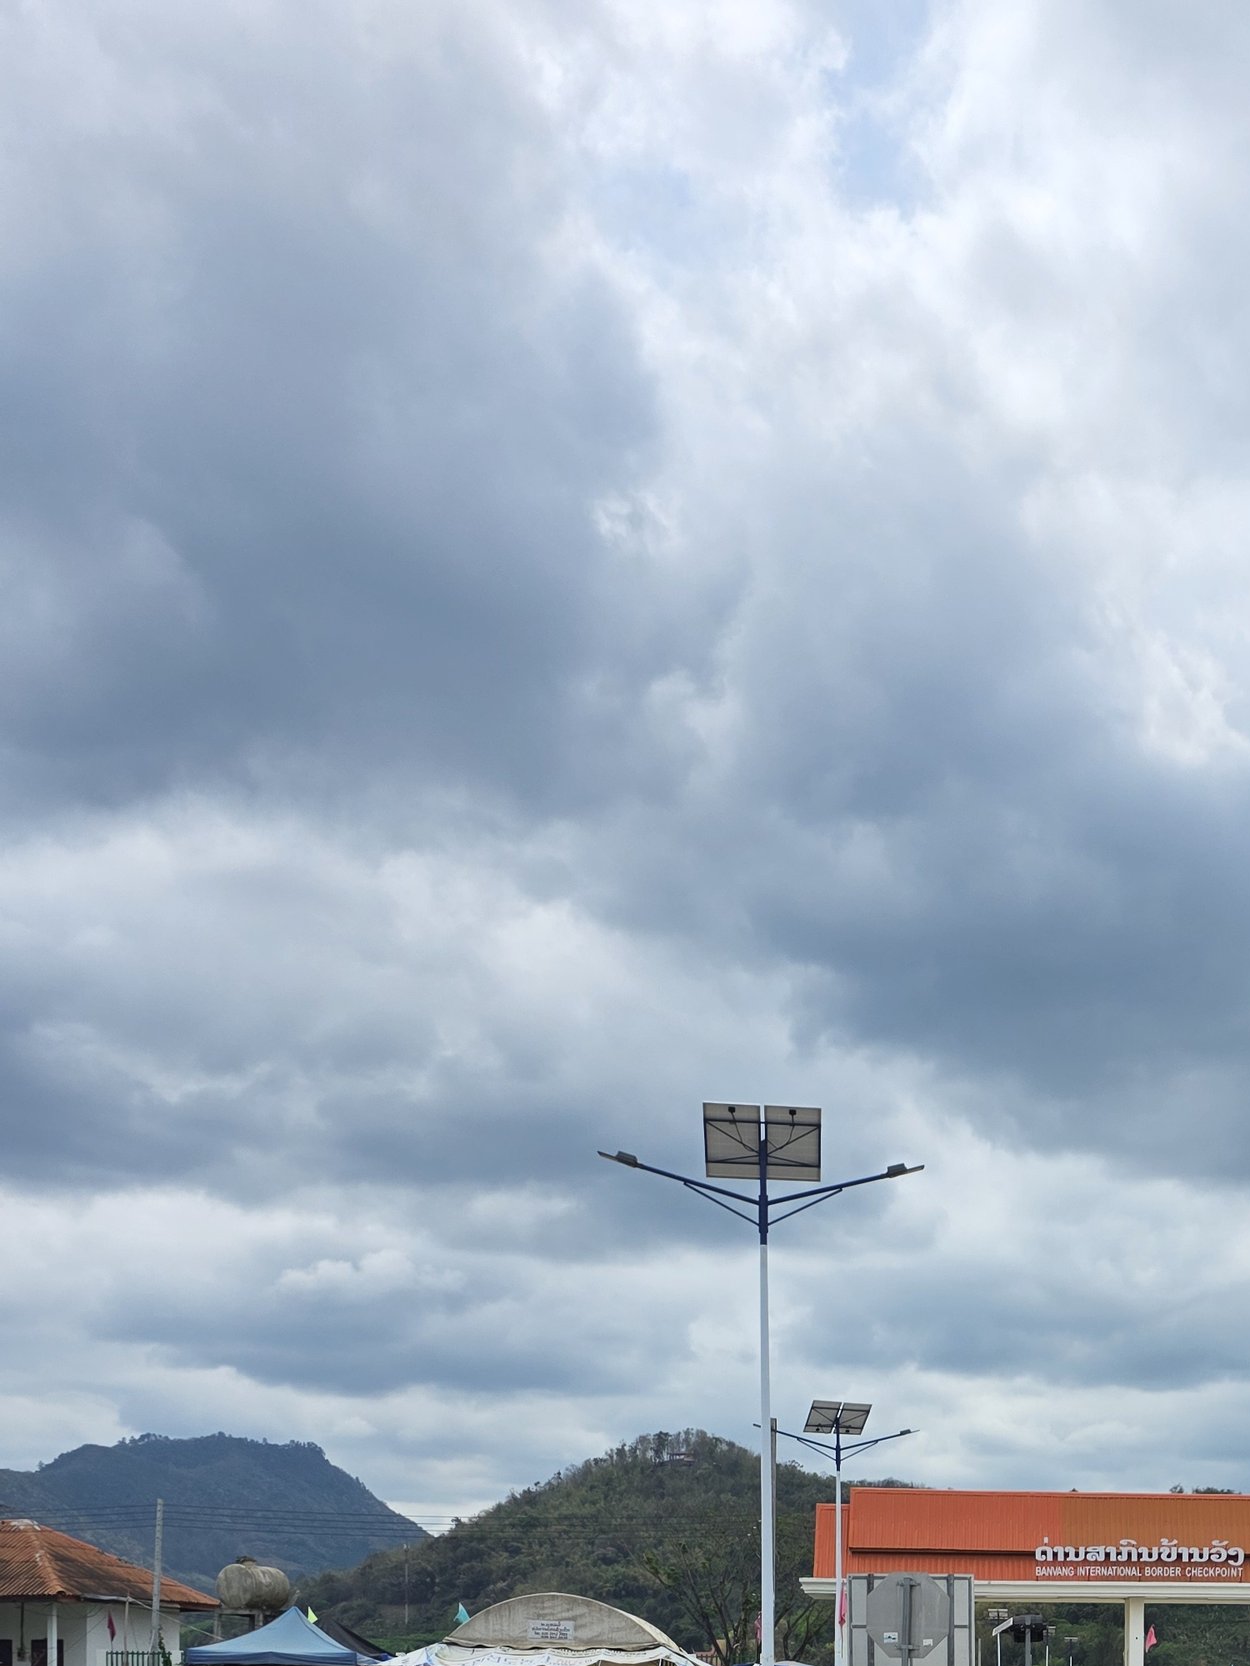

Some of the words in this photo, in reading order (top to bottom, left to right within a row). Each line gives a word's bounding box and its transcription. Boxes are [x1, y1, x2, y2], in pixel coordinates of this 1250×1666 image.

[1035, 1566, 1075, 1577] BANVANG
[1077, 1566, 1142, 1577] INTERNATIONAL
[1144, 1567, 1182, 1577] BORDER
[1185, 1567, 1244, 1577] CHECKPOINT
